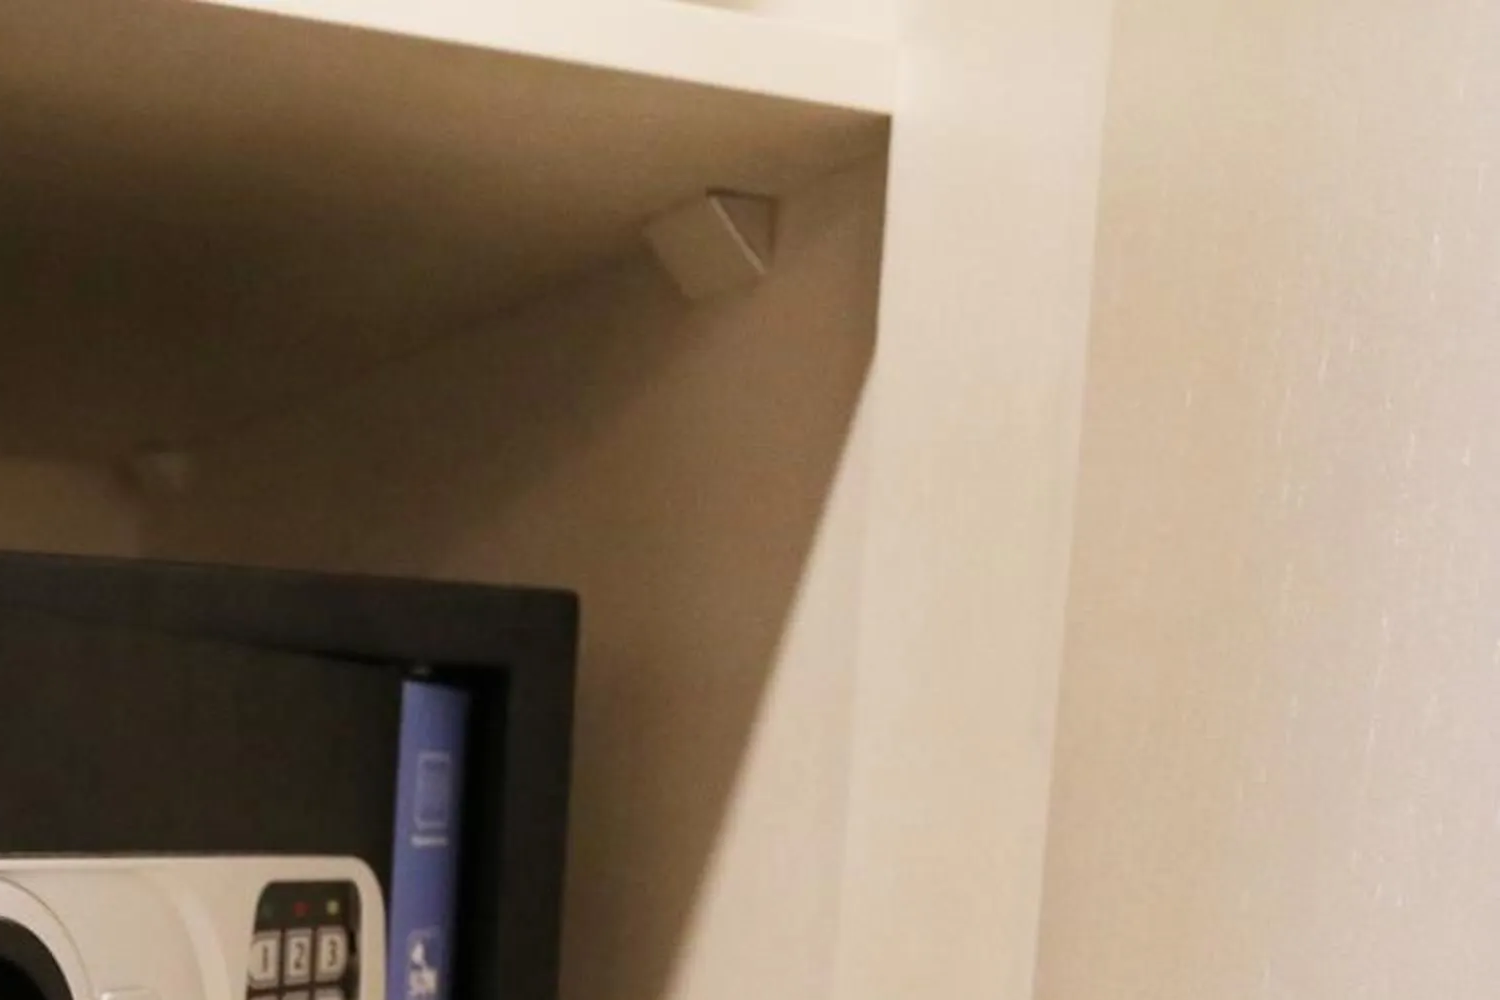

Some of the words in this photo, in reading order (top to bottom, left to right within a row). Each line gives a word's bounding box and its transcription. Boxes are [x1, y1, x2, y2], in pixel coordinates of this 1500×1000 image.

[260, 944, 270, 972] 1
[293, 941, 305, 970] 2
[327, 939, 338, 967] 3
